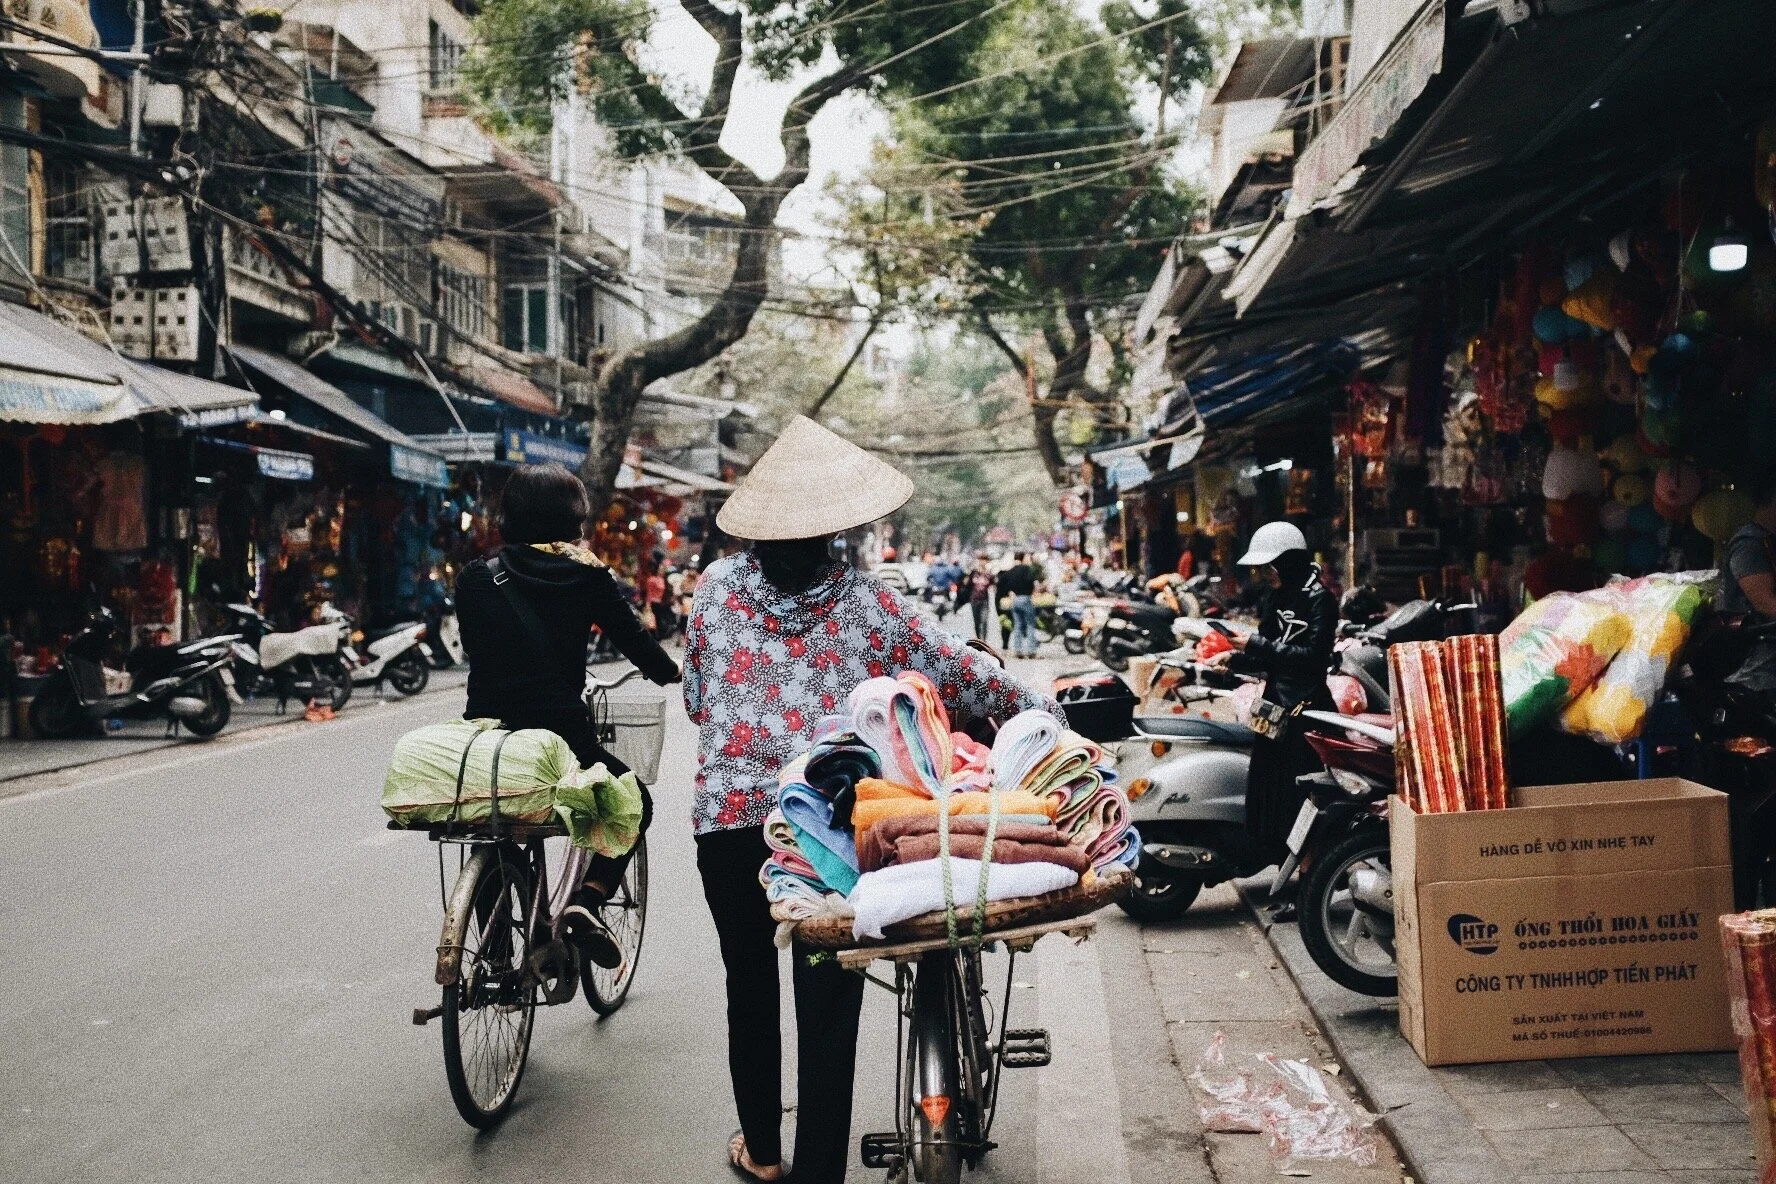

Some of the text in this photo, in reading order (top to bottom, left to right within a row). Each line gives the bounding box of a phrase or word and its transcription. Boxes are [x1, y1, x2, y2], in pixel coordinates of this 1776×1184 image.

[1479, 843, 1519, 857] HÀNG
[1571, 838, 1593, 852] XIN
[1630, 835, 1655, 847] TAY
[1462, 923, 1498, 940] HTP
[1514, 917, 1551, 937] ỐNG
[1611, 915, 1649, 931] HOA
[1656, 906, 1700, 929] GIẤY
[1455, 973, 1501, 993] CÔNG
[1505, 974, 1525, 990] TY
[1614, 960, 1650, 984] TIẾN
[1655, 961, 1698, 981] PHÁT
[1619, 1009, 1644, 1019] NAM
